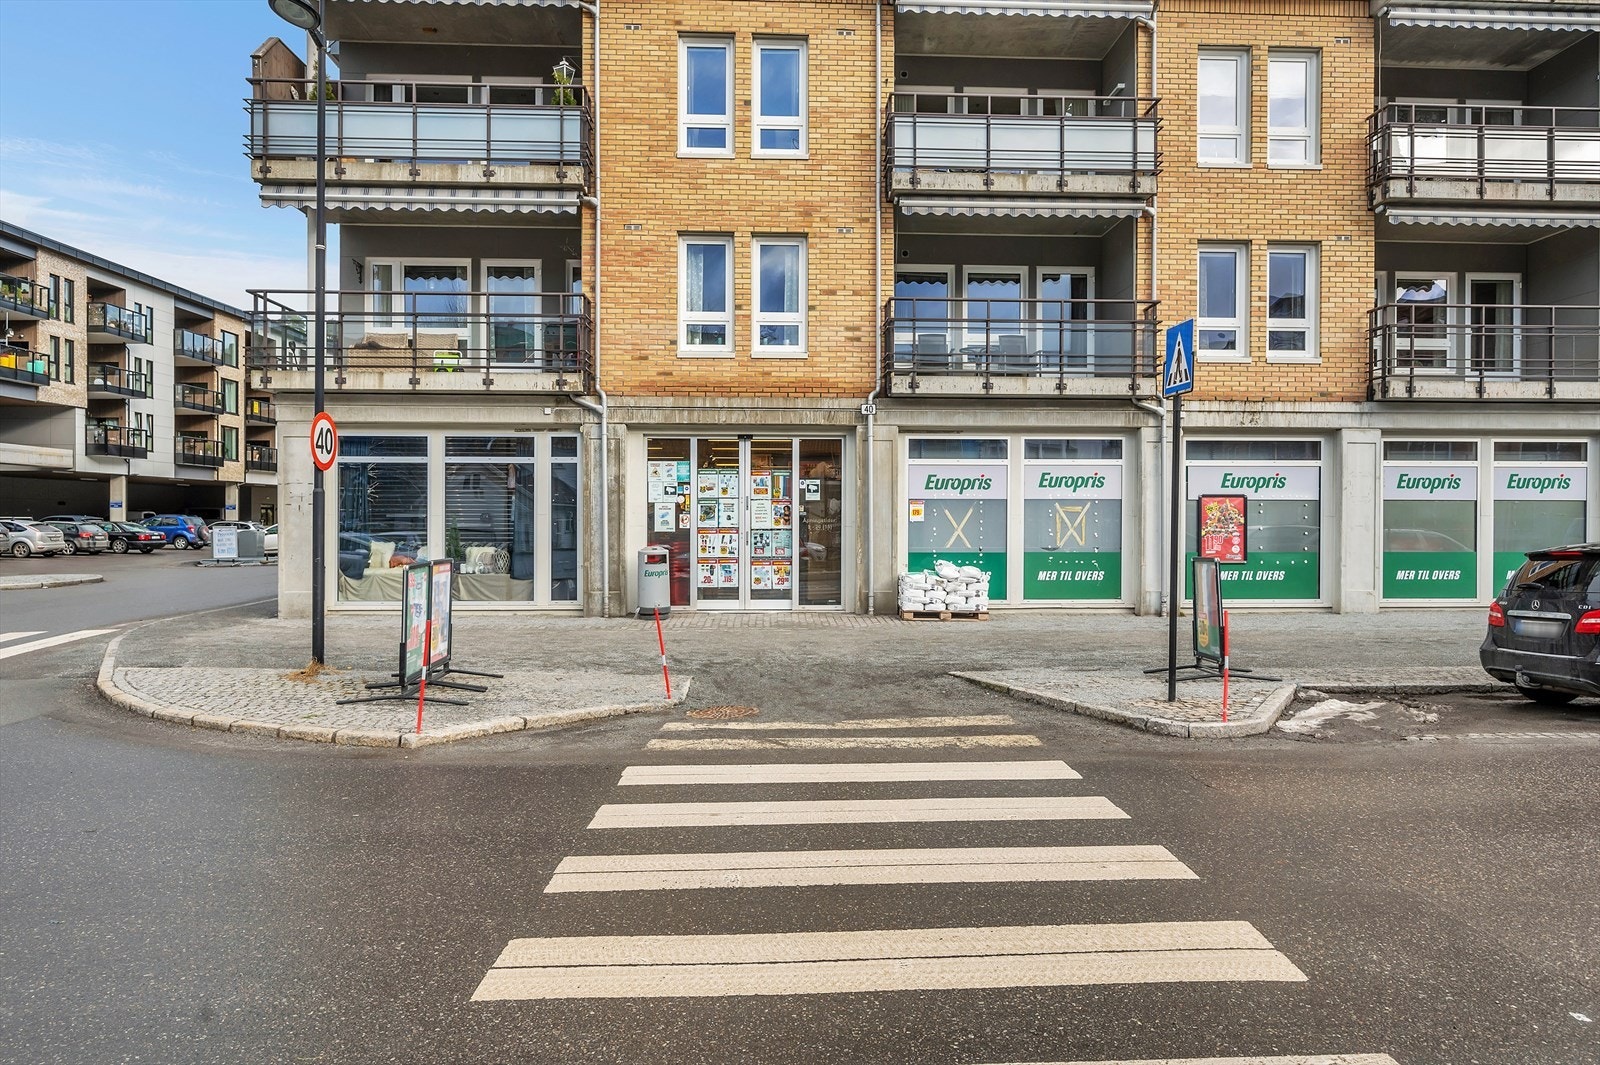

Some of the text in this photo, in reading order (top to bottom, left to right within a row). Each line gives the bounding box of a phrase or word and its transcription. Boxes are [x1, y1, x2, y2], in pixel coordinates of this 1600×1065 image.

[864, 405, 874, 414] 40
[315, 427, 333, 455] 40
[924, 473, 992, 495] Europris
[1038, 472, 1106, 493] Europris
[1220, 472, 1287, 494] Europris
[1396, 473, 1462, 494] Europris
[1506, 473, 1571, 494] Europris
[1037, 570, 1105, 581] MER TIL OVERS
[1219, 570, 1286, 581] MER TIL OVERS
[1395, 570, 1461, 581] MER TIL OVERS
